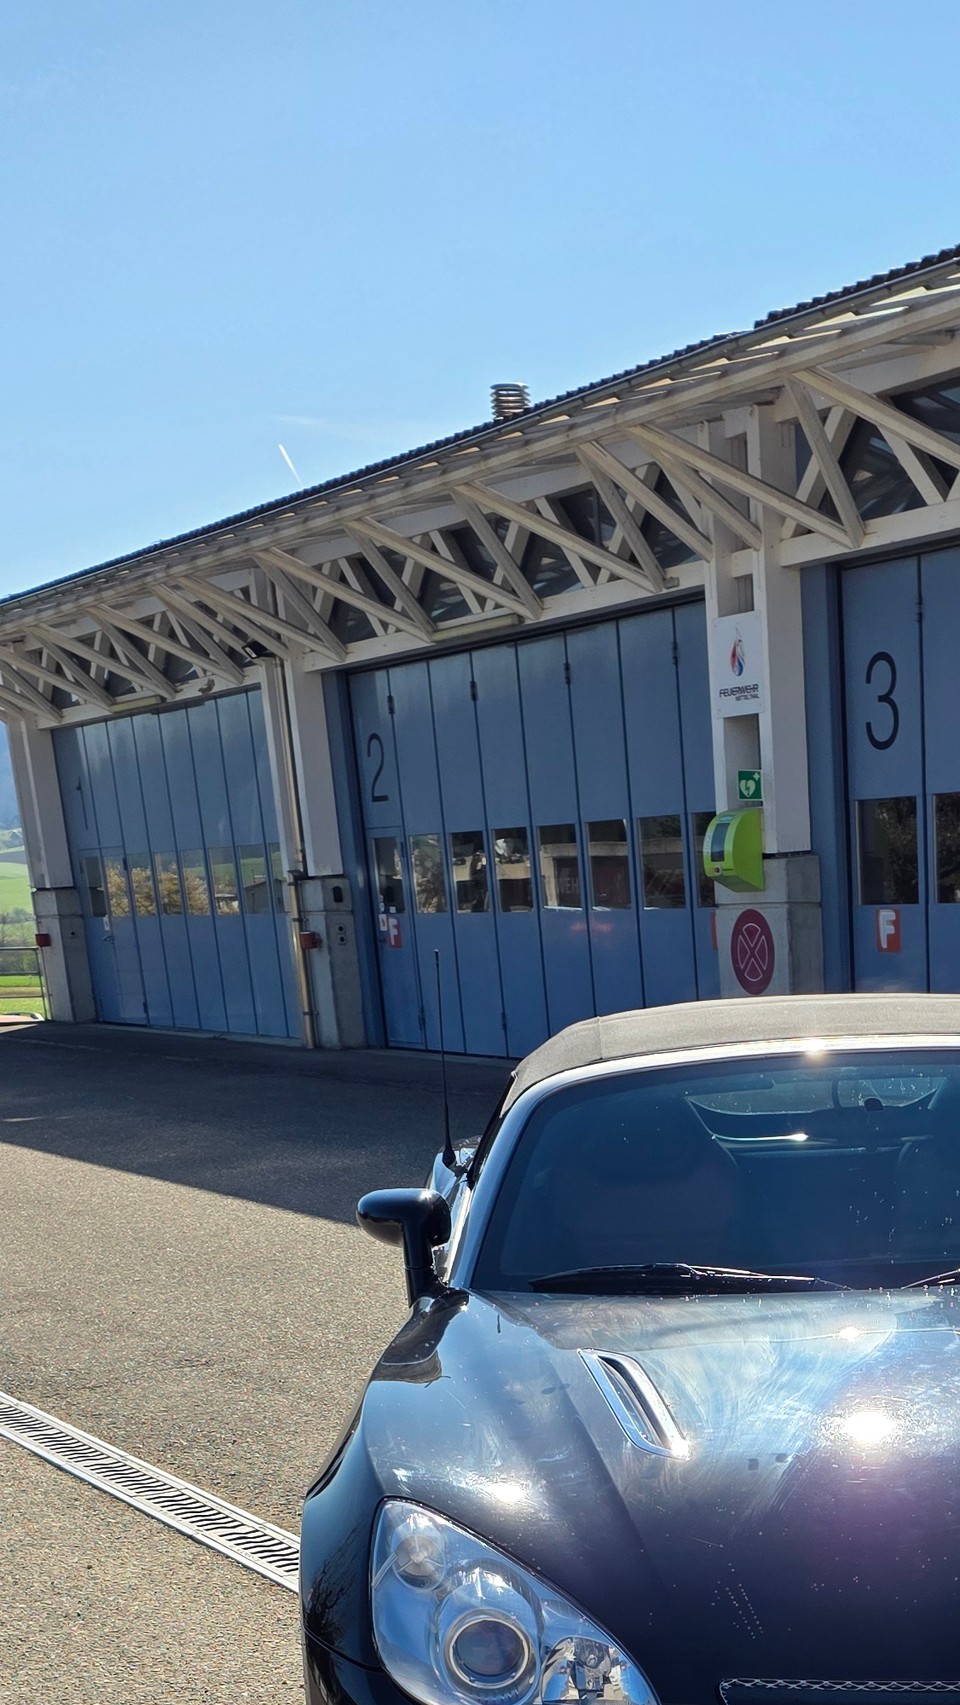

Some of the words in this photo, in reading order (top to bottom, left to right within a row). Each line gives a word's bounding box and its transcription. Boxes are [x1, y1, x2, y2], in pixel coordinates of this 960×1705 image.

[719, 683, 759, 698] FEUERWEHR
[865, 651, 899, 750] 3
[367, 732, 389, 803] 2
[388, 918, 398, 946] F
[879, 909, 896, 949] F
